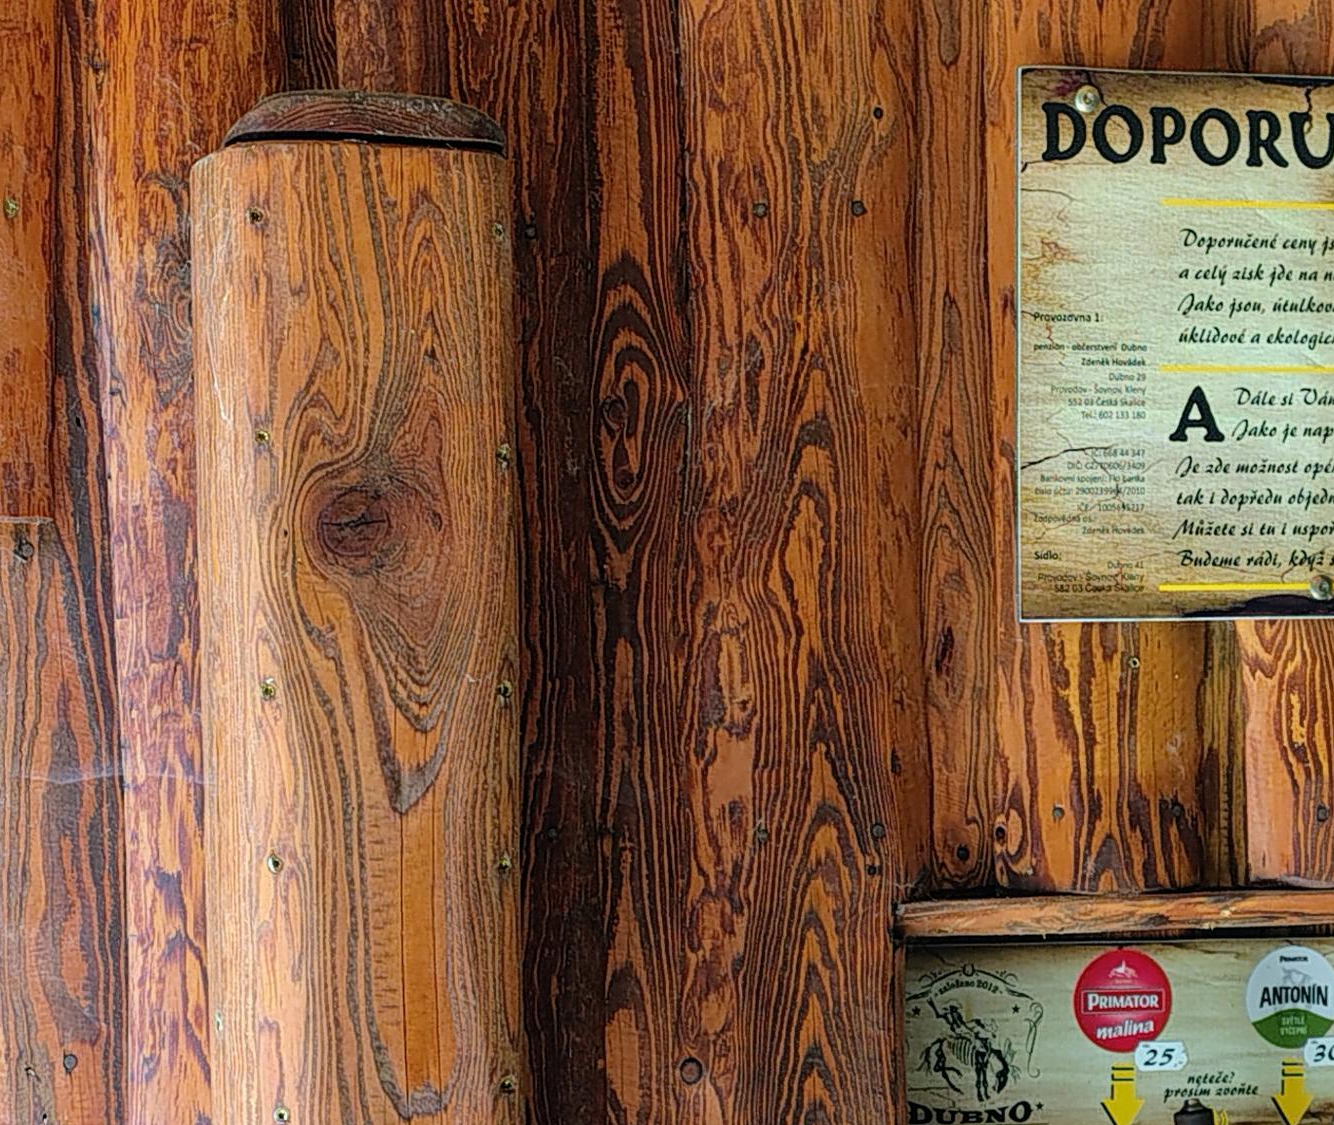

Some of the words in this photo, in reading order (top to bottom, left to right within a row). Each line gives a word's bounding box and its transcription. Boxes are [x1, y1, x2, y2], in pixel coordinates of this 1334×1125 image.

[1179, 228, 1277, 254] Doporučené
[1282, 239, 1316, 255] ceny
[1194, 264, 1227, 285] celý
[1232, 263, 1264, 281] zisk
[1269, 264, 1293, 286] jde
[1177, 293, 1224, 316] Jako
[1228, 298, 1266, 318] jsou,
[1178, 326, 1246, 345] úklidové
[1168, 385, 1225, 443] A
[1233, 387, 1276, 407] Dále
[1231, 419, 1277, 441] Jako
[1175, 456, 1200, 477] Je
[1205, 457, 1231, 474] zde
[1235, 458, 1299, 475] možnost
[1176, 488, 1203, 505] tak
[1220, 488, 1283, 511] dopředu
[1172, 519, 1236, 540] Můžete
[1178, 549, 1242, 568] Budeme
[1246, 550, 1282, 569] rádi,
[1288, 550, 1324, 572] když
[976, 979, 999, 994] 2012
[1259, 984, 1328, 1009] ANTONÍN
[1087, 993, 1160, 1012] PRIMATOR
[1096, 1019, 1155, 1040] malina
[1164, 1084, 1210, 1103] prosím
[1216, 1084, 1259, 1096] zvoňte
[907, 1100, 1033, 1125] DUBNO
